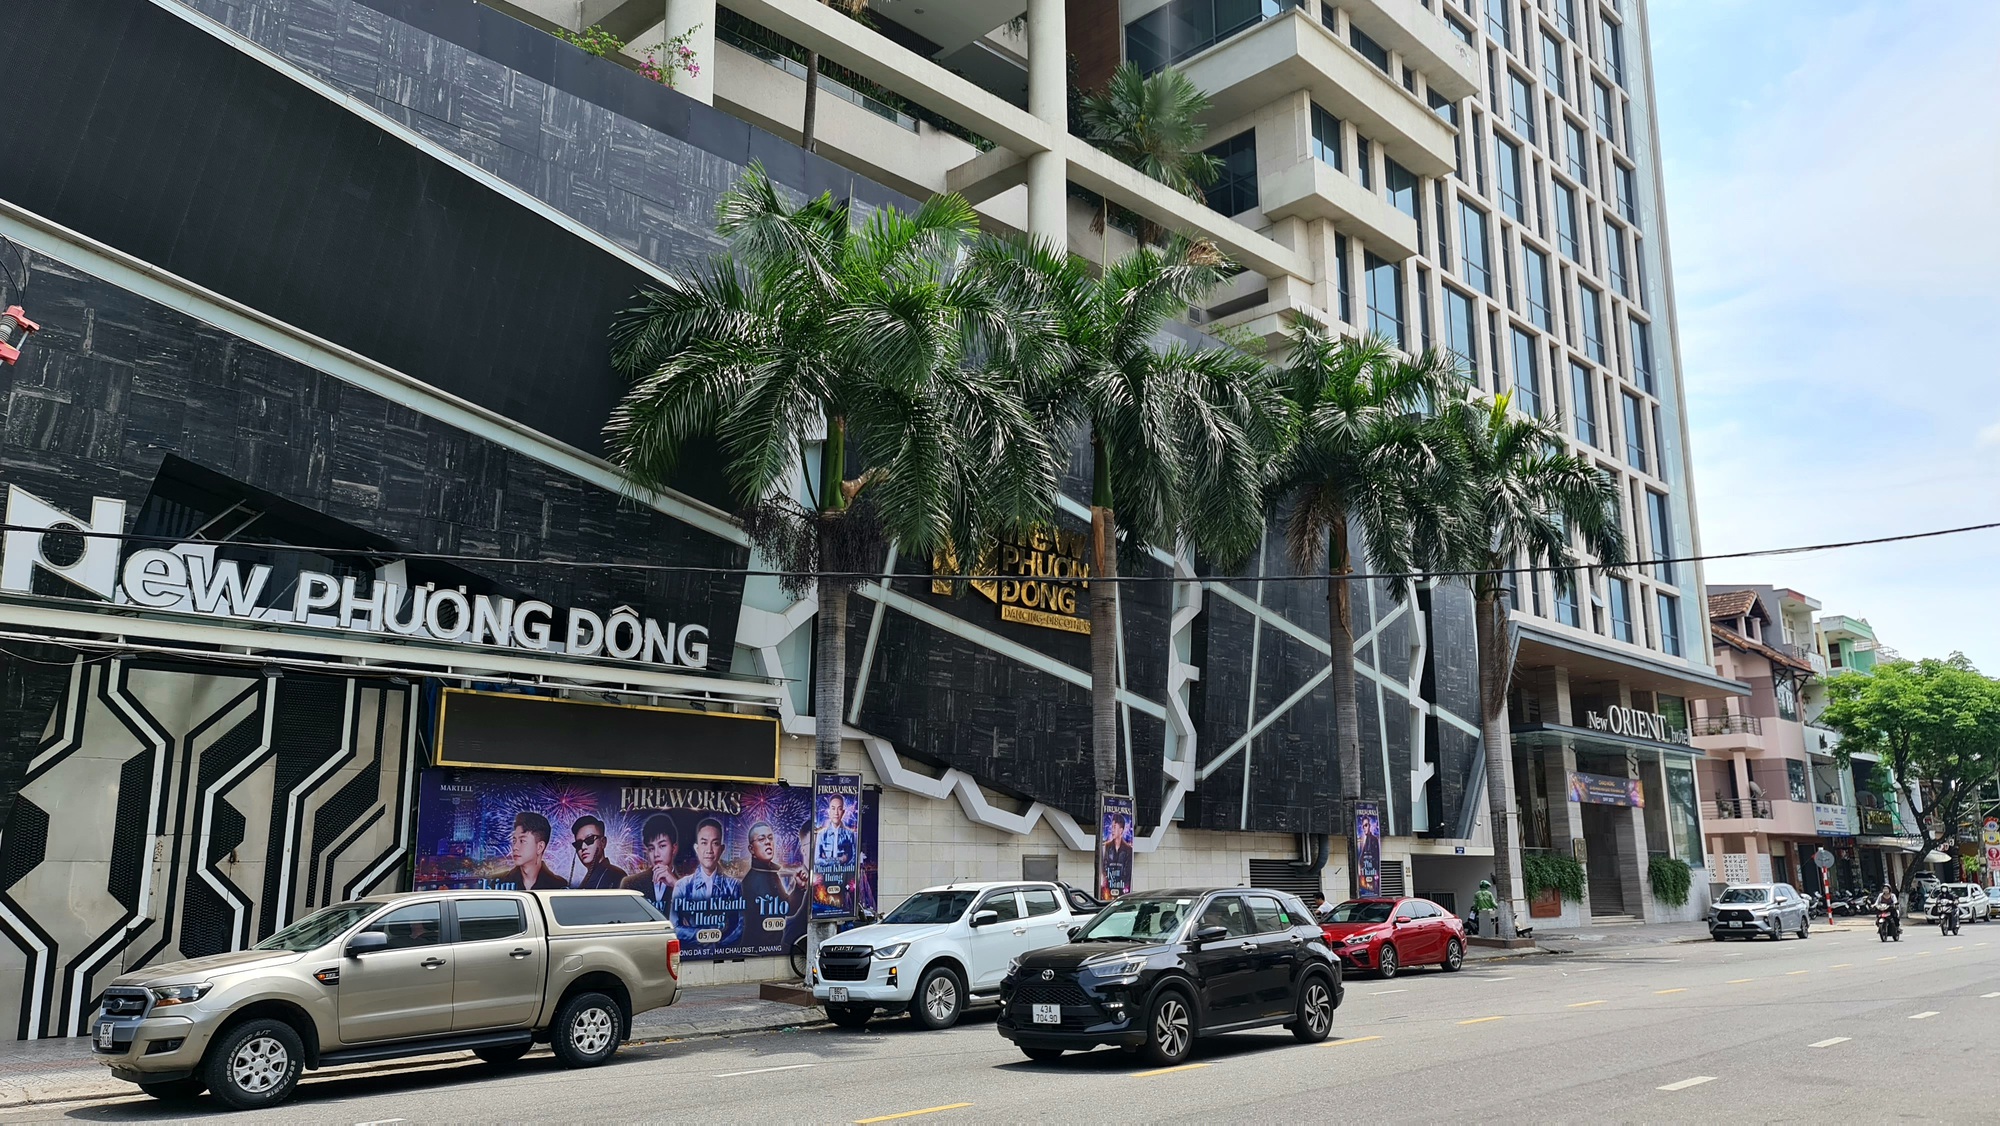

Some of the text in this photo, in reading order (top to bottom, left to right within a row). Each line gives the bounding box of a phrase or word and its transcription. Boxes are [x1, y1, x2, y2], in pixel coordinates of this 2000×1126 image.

[293, 569, 553, 651] PHƯƠNG
[564, 604, 710, 669] ĐÔNG
[1586, 710, 1608, 732] New
[1607, 704, 1667, 742] ORIENT
[440, 784, 474, 793] MARTELL
[817, 785, 859, 795] FIREWORKS
[620, 786, 741, 815] FIREWORKS
[674, 895, 747, 915] Phạm Khánh
[764, 921, 784, 929] 19/06
[698, 931, 720, 941] 05/06
[714, 947, 724, 955] HAI
[725, 946, 741, 954] CHAU
[759, 945, 782, 953] DANANG
[1040, 1005, 1052, 1014] 43A
[1036, 1014, 1058, 1023] 704.90
